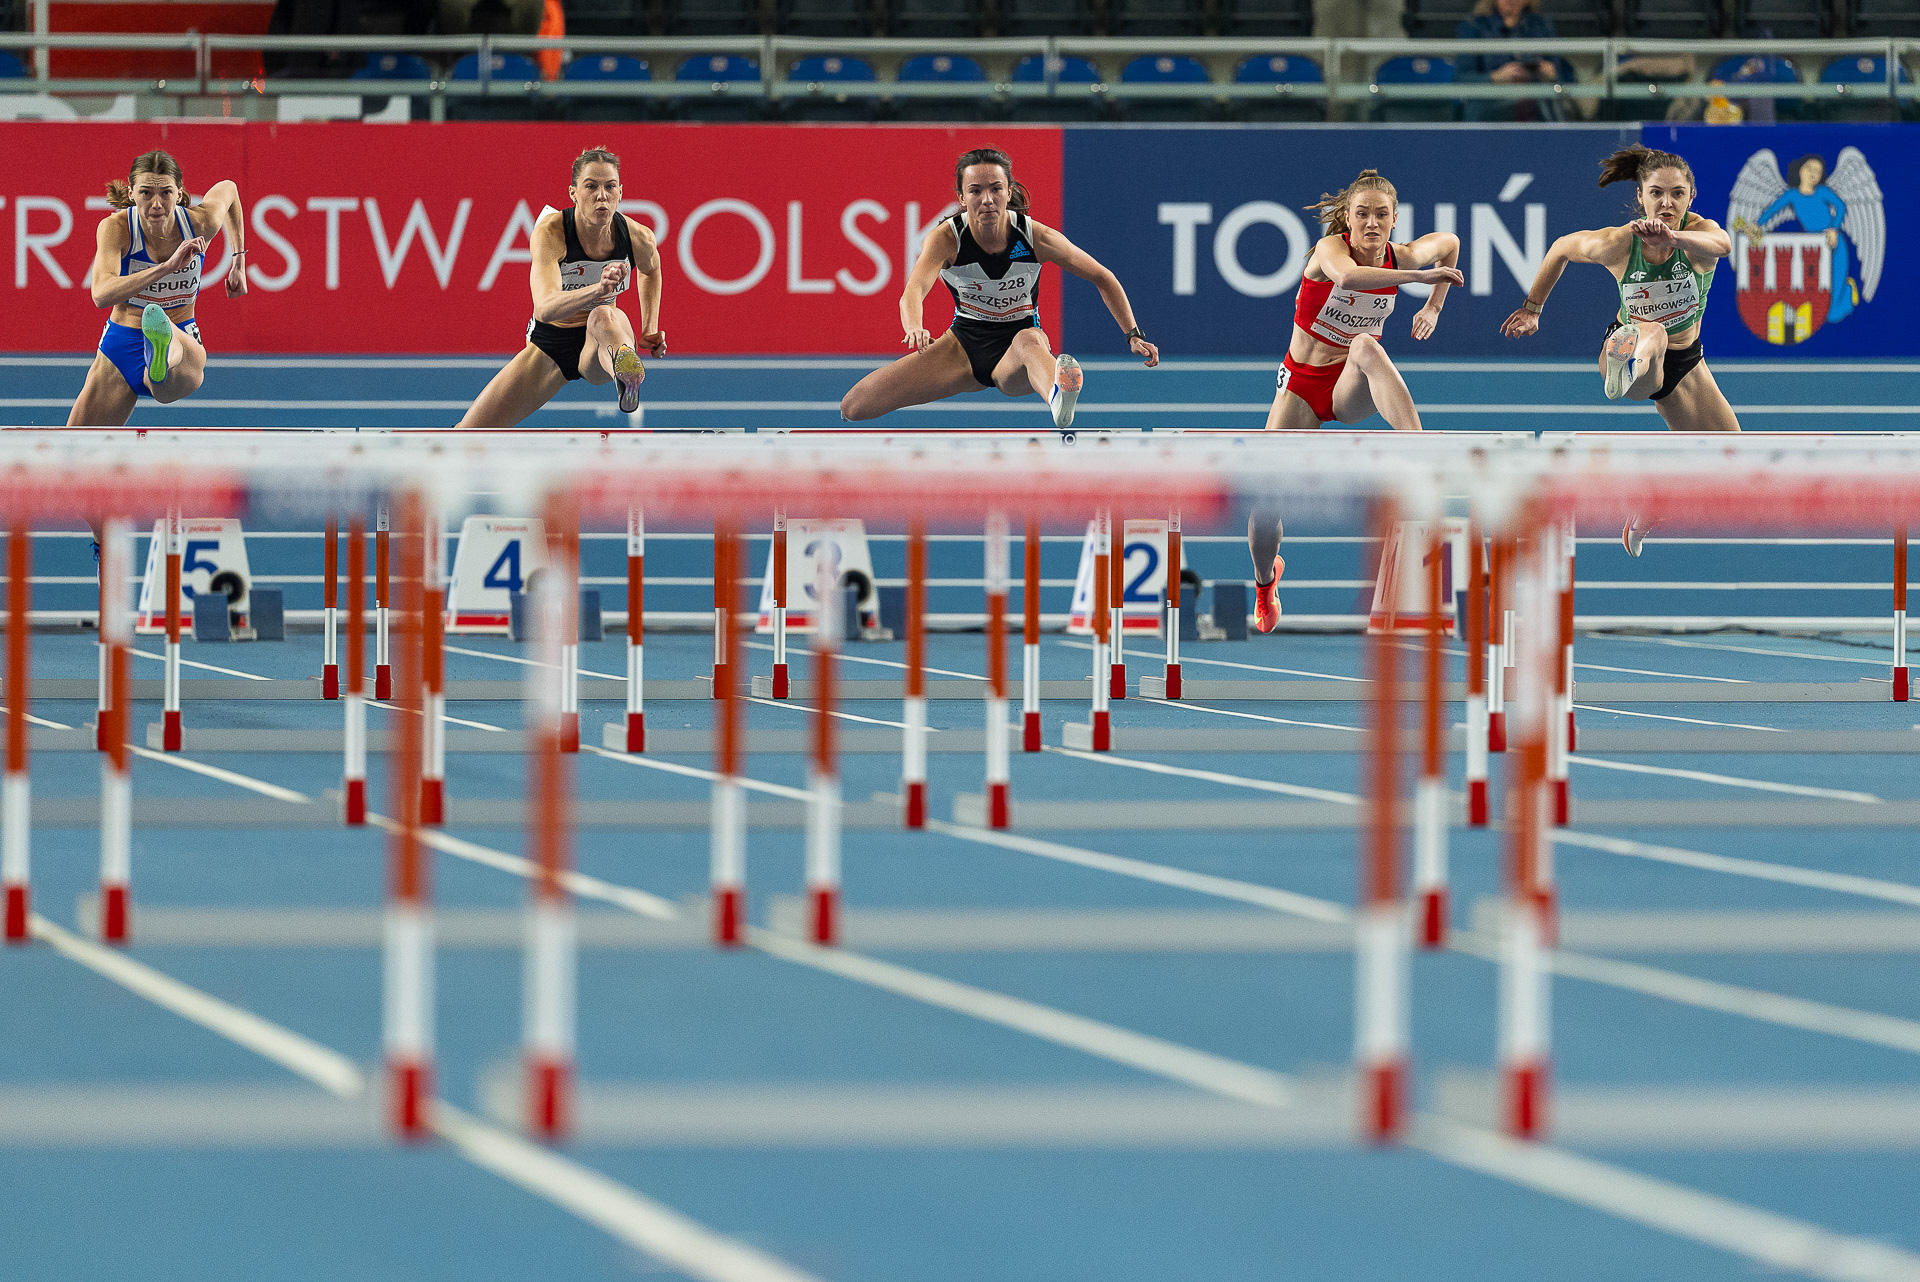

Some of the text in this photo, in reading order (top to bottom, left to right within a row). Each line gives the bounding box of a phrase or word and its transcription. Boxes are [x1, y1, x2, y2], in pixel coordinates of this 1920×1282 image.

[1158, 173, 1547, 298] TOUŃ
[1009, 250, 1030, 260] adidas
[144, 276, 198, 293] EPURA
[998, 277, 1026, 292] 228
[1629, 270, 1647, 282] 4F
[1665, 280, 1692, 294] 174
[961, 291, 1028, 310] SZCZĘSNA
[1372, 298, 1389, 310] 93
[1627, 295, 1697, 316] SKIERKOWSKA
[1324, 305, 1385, 328] WŁOSZCZYK
[1328, 331, 1349, 345] TORUŃ
[181, 540, 219, 602] 5
[483, 539, 524, 592] 4
[803, 538, 843, 602] 3
[1123, 542, 1159, 603] 2
